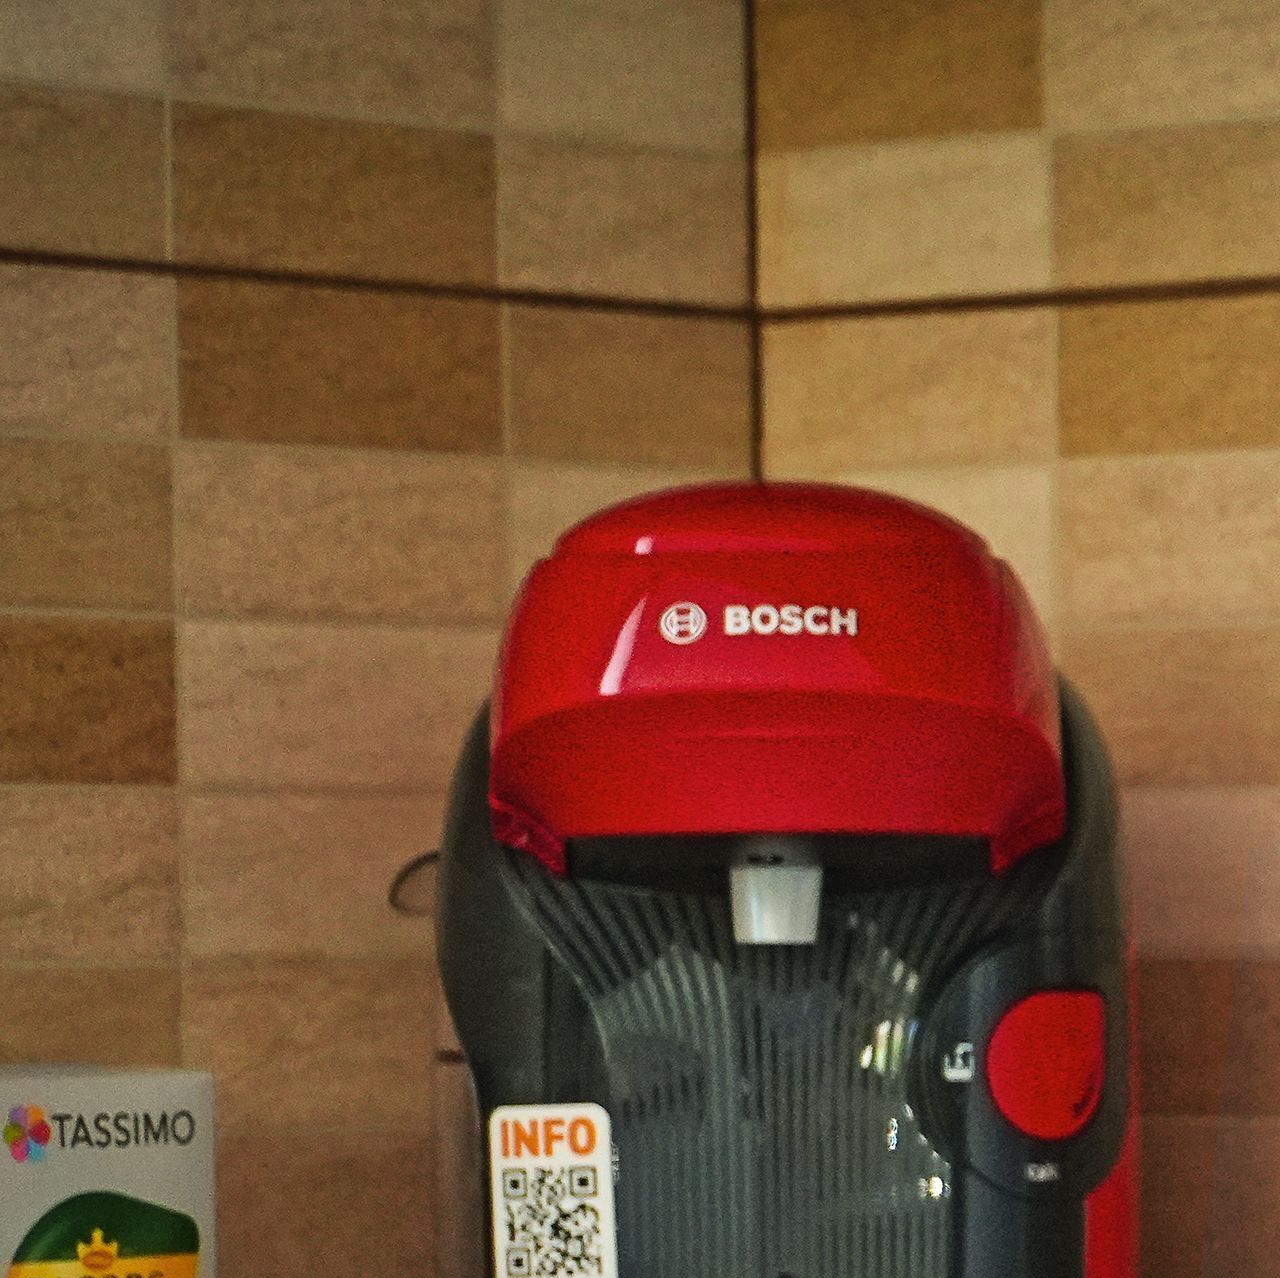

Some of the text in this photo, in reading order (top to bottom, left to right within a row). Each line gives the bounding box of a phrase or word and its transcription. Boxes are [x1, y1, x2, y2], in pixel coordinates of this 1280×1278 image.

[724, 604, 858, 636] BOSCH
[52, 1109, 196, 1149] TASSIMO
[501, 1116, 597, 1158] INFO
